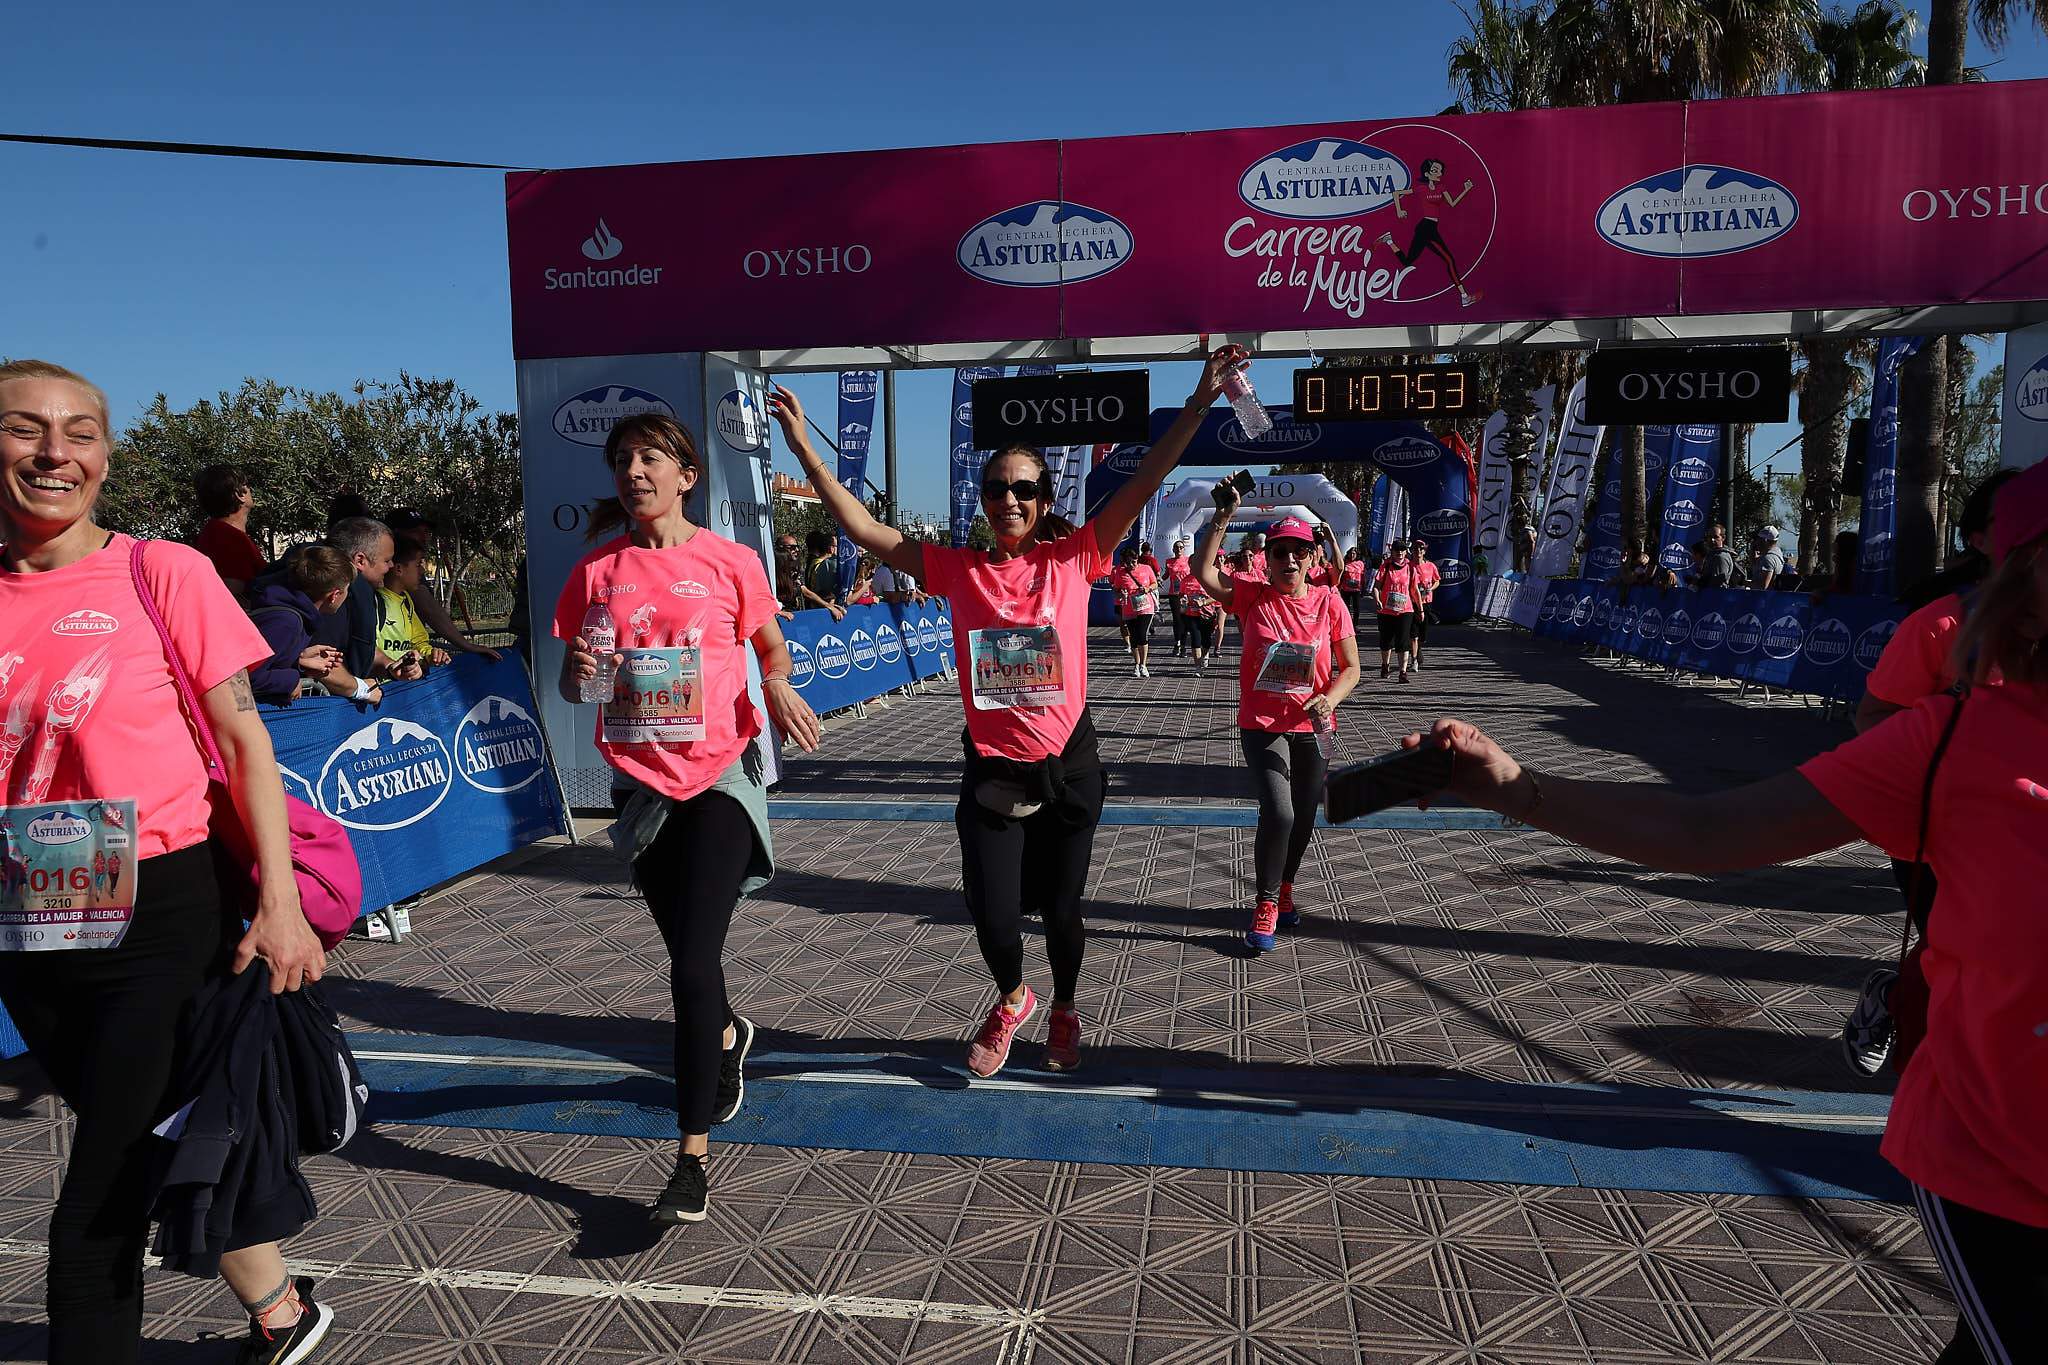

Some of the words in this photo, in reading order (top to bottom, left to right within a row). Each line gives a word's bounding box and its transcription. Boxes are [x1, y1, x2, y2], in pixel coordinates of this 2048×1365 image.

[1278, 165, 1332, 176] CENTRAL
[1337, 163, 1392, 174] LECHERA
[1251, 170, 1396, 200] ASTURIANA
[1642, 196, 1704, 209] CENTRAL
[1711, 193, 1777, 204] LECHERA
[1611, 202, 1783, 236] ASTURIANA
[997, 230, 1053, 241] CENTRAL
[1224, 217, 1363, 258] Carrera
[743, 244, 872, 278] OYSHO
[970, 236, 1121, 268] ASTURIANA
[545, 264, 662, 290] Santander
[1258, 259, 1283, 288] de
[1289, 258, 1308, 287] la
[1303, 249, 1416, 318] Mujer
[1619, 371, 1761, 401] OYSHO
[1001, 395, 1124, 425] OYSHO
[1225, 426, 1313, 443] ASURIANA
[720, 500, 767, 528] OYSHO
[599, 584, 637, 597] OYSHO
[56, 621, 113, 632] ASTURIANA
[354, 754, 396, 772] CENTRAL
[466, 736, 541, 775] ASTURIAN
[335, 757, 447, 815] ASTURIANA
[31, 824, 87, 838] ASTURIANA
[30, 867, 91, 893] 016
[28, 914, 38, 922] DE
[54, 911, 83, 921] MUJER
[89, 910, 125, 920] VALENCIA
[43, 898, 72, 909] 3210
[5, 931, 45, 942] OYSHO
[77, 930, 118, 940] Santander
